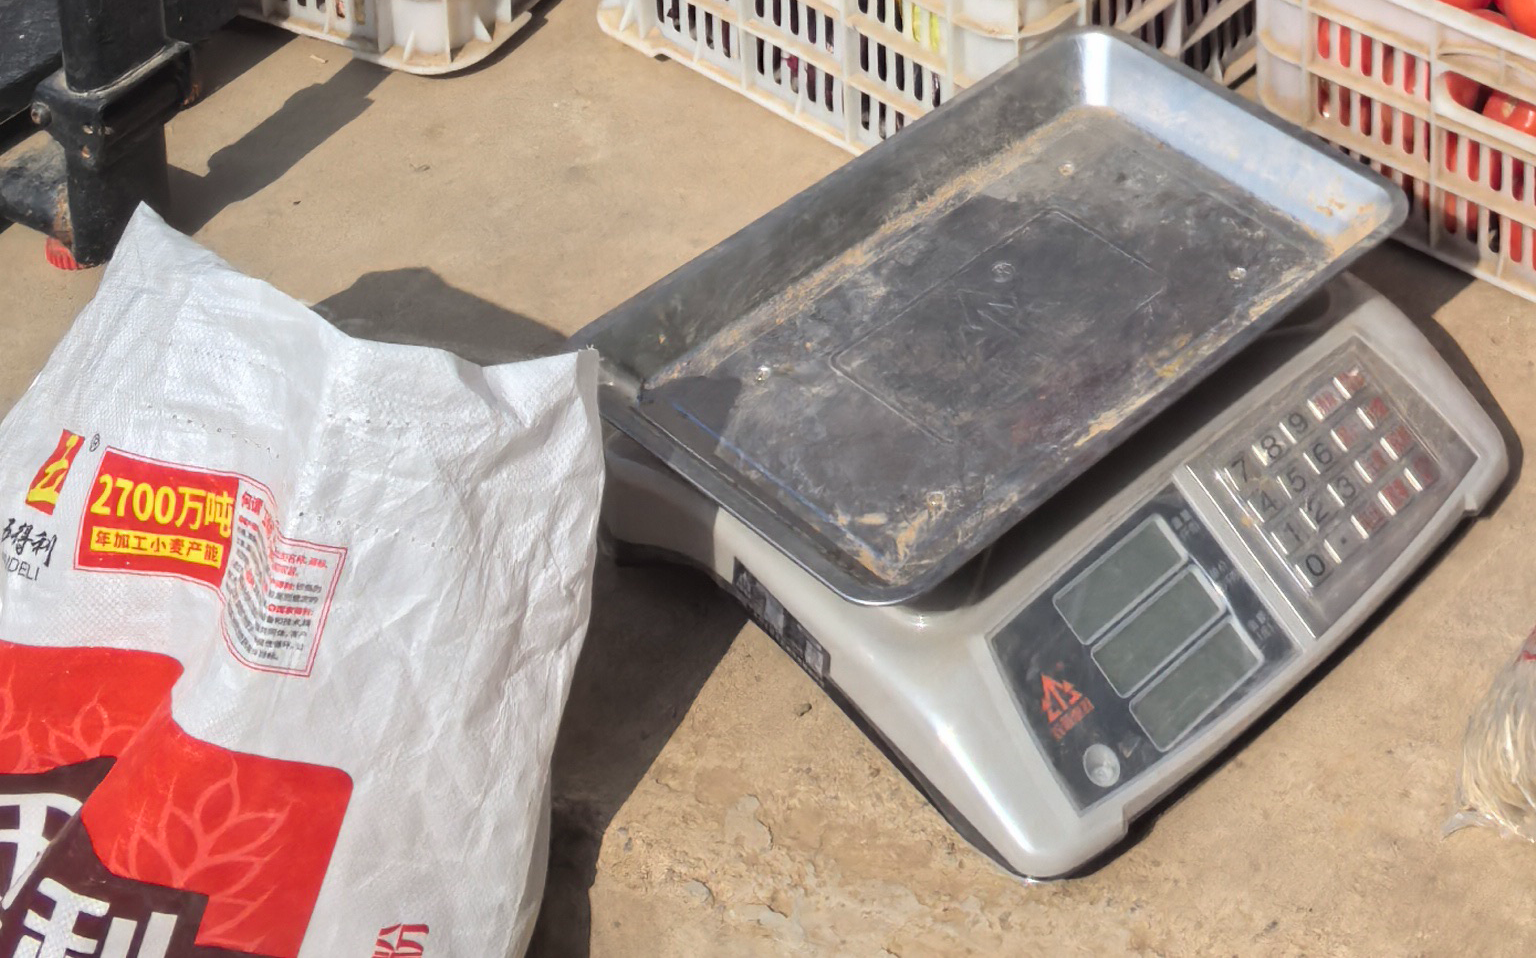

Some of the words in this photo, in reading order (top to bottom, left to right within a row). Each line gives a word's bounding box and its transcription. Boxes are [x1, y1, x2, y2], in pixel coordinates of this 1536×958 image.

[1231, 451, 1249, 483] 7
[1261, 435, 1283, 460] 8
[1288, 412, 1309, 434] 9
[1260, 490, 1278, 512] 4
[1286, 468, 1307, 493] 5
[1312, 443, 1333, 465] 6
[90, 473, 235, 539] 2700万吨
[1287, 522, 1301, 542] 1
[1307, 494, 1329, 524] 2
[1336, 477, 1356, 500] 3
[94, 530, 220, 563] 年加工小麦产能
[1305, 553, 1326, 577] 0
